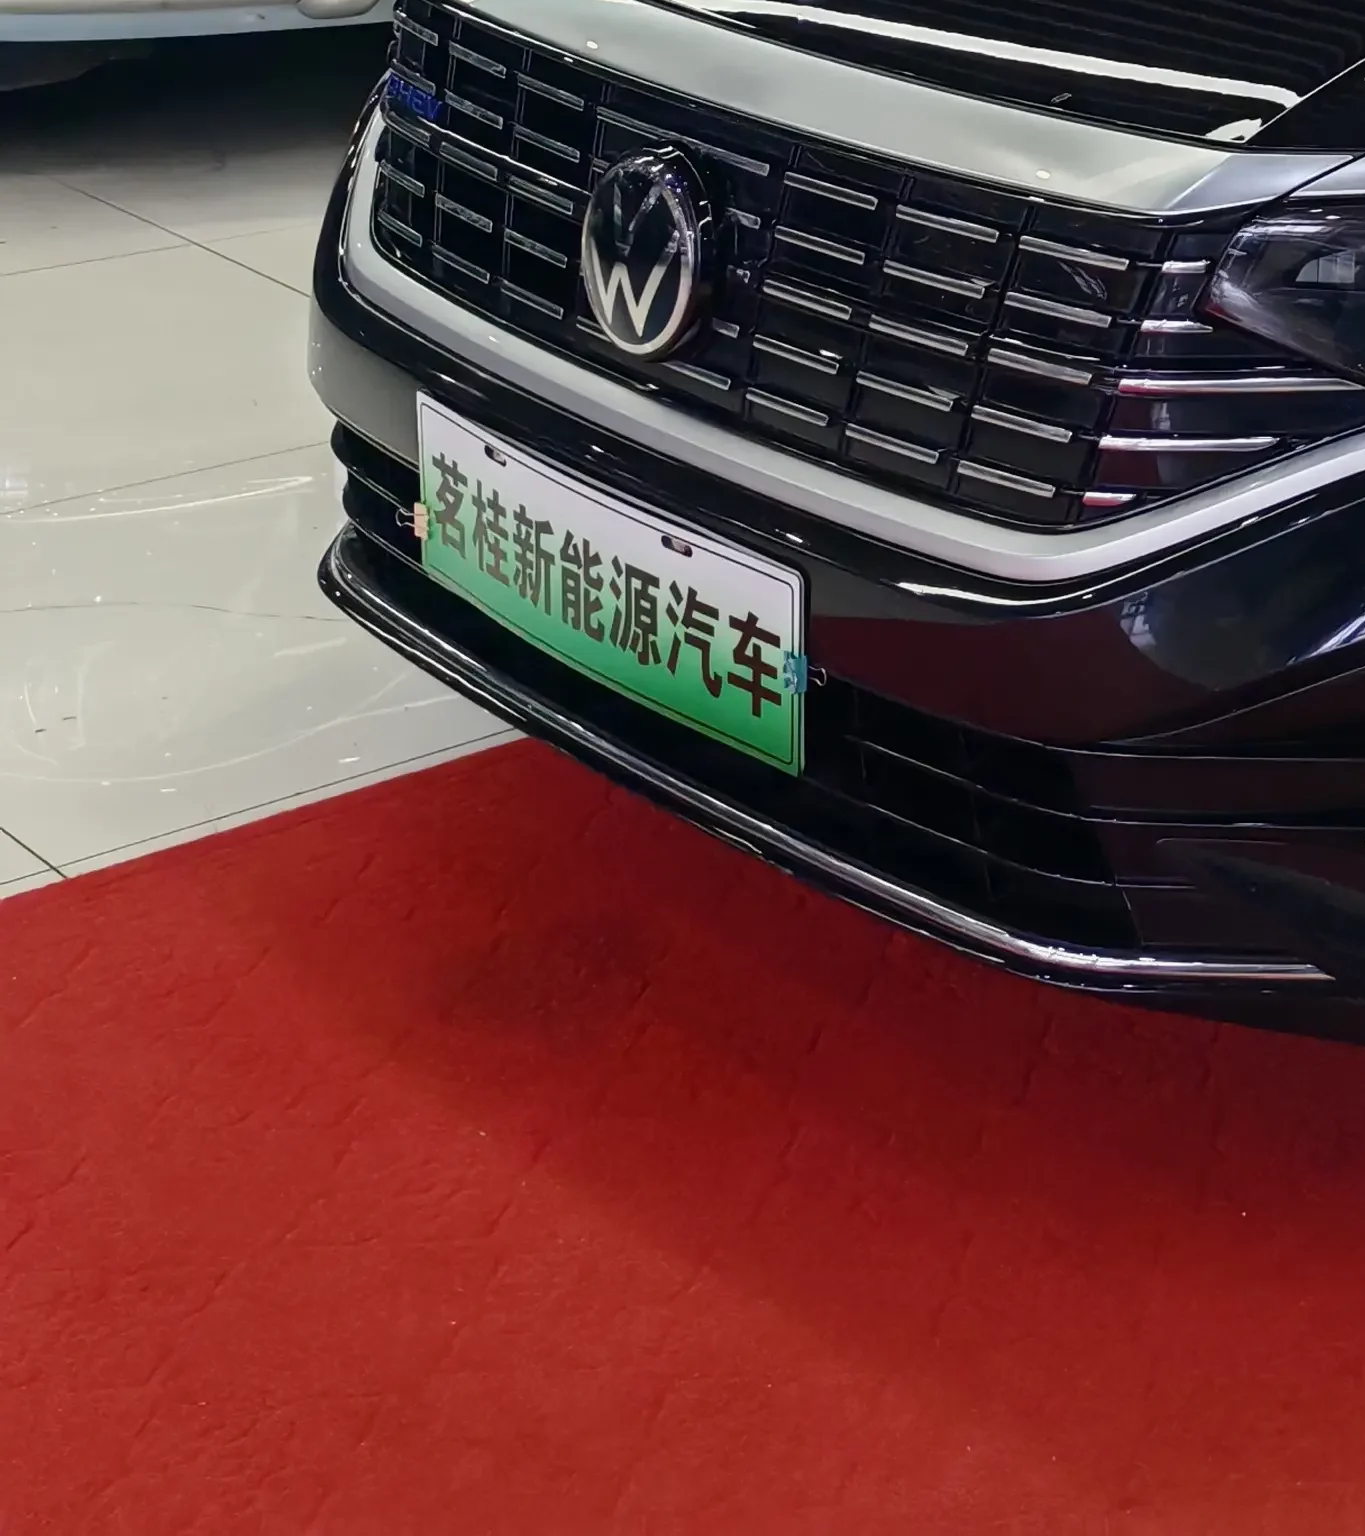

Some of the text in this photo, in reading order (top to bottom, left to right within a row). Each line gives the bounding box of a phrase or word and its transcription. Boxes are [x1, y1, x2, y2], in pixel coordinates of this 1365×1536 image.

[429, 450, 785, 720] 茗桂新能源汽车
